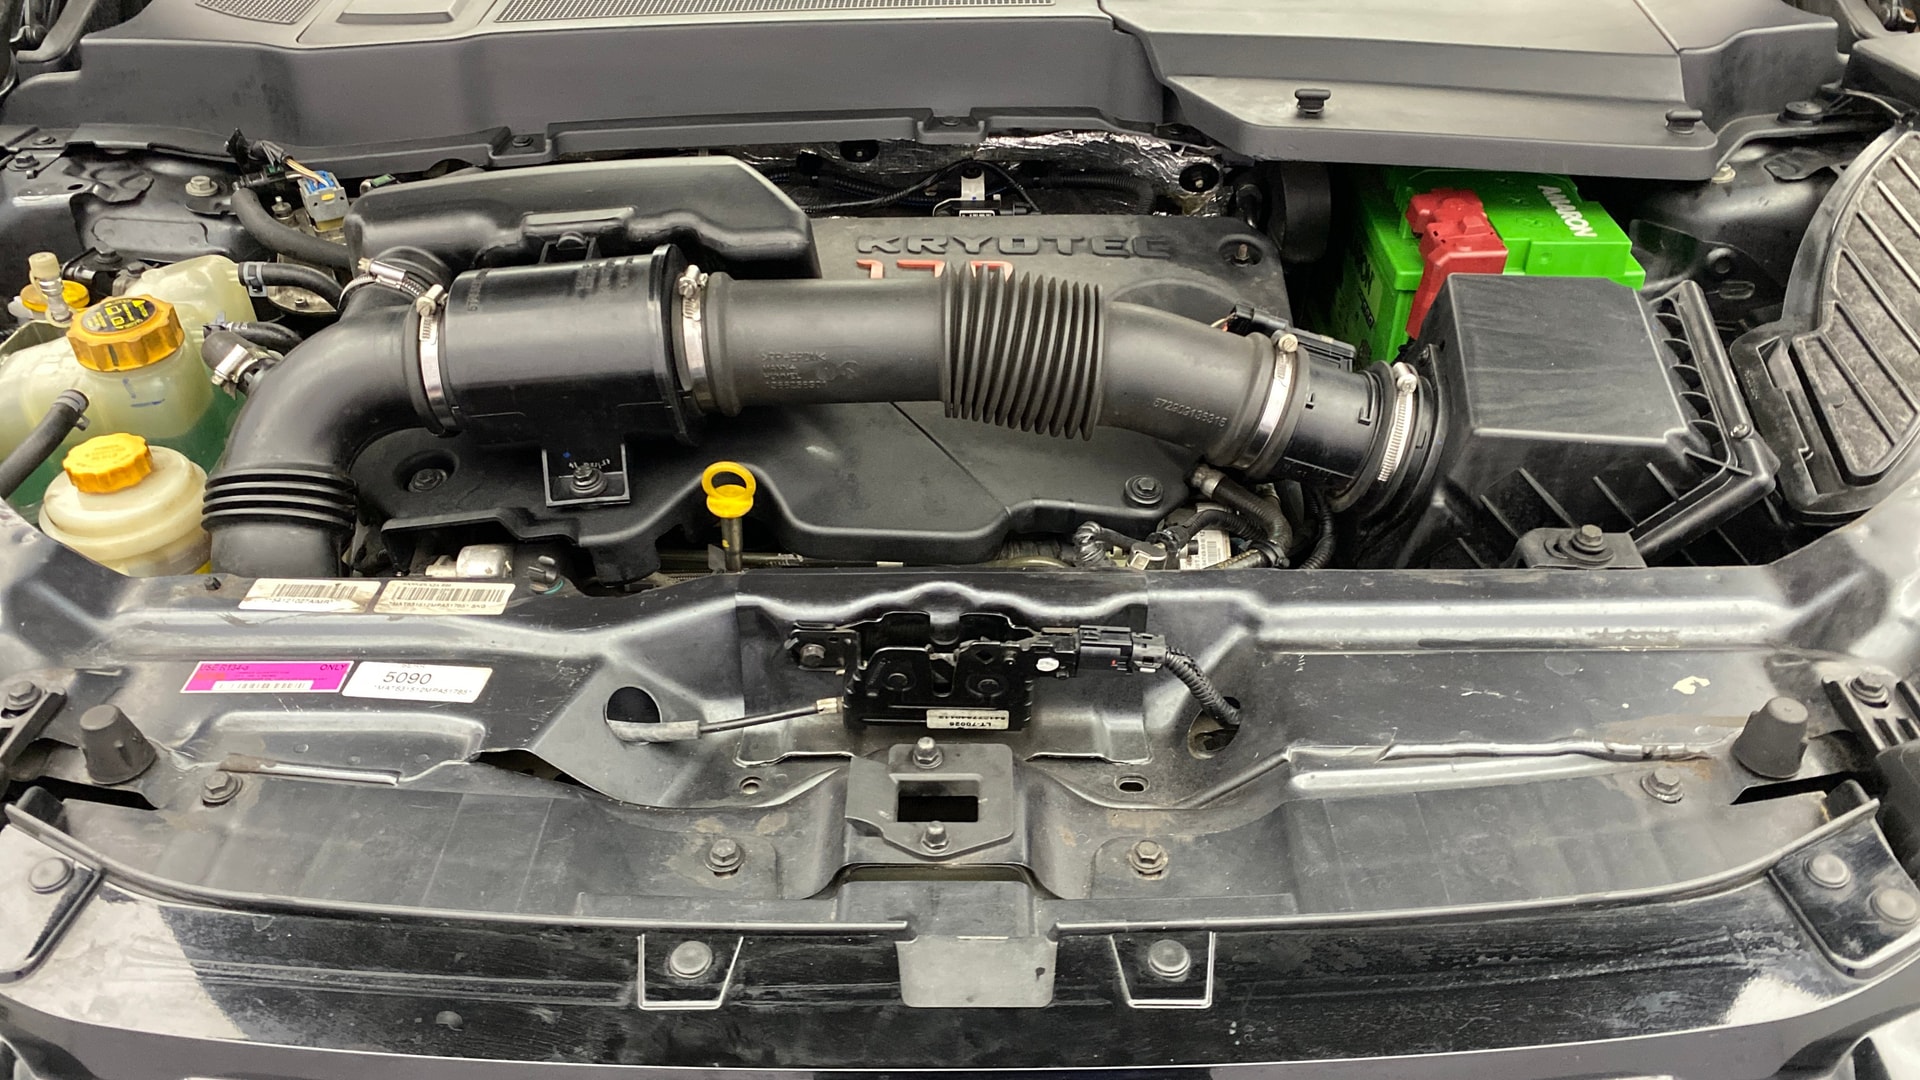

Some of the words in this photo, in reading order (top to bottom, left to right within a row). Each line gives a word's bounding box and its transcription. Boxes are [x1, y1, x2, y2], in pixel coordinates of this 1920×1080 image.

[1538, 185, 1597, 237] AMARON
[856, 236, 1171, 259] KRYOTEC
[200, 662, 219, 672] USE
[319, 663, 346, 672] ONLY
[383, 671, 432, 685] 5090
